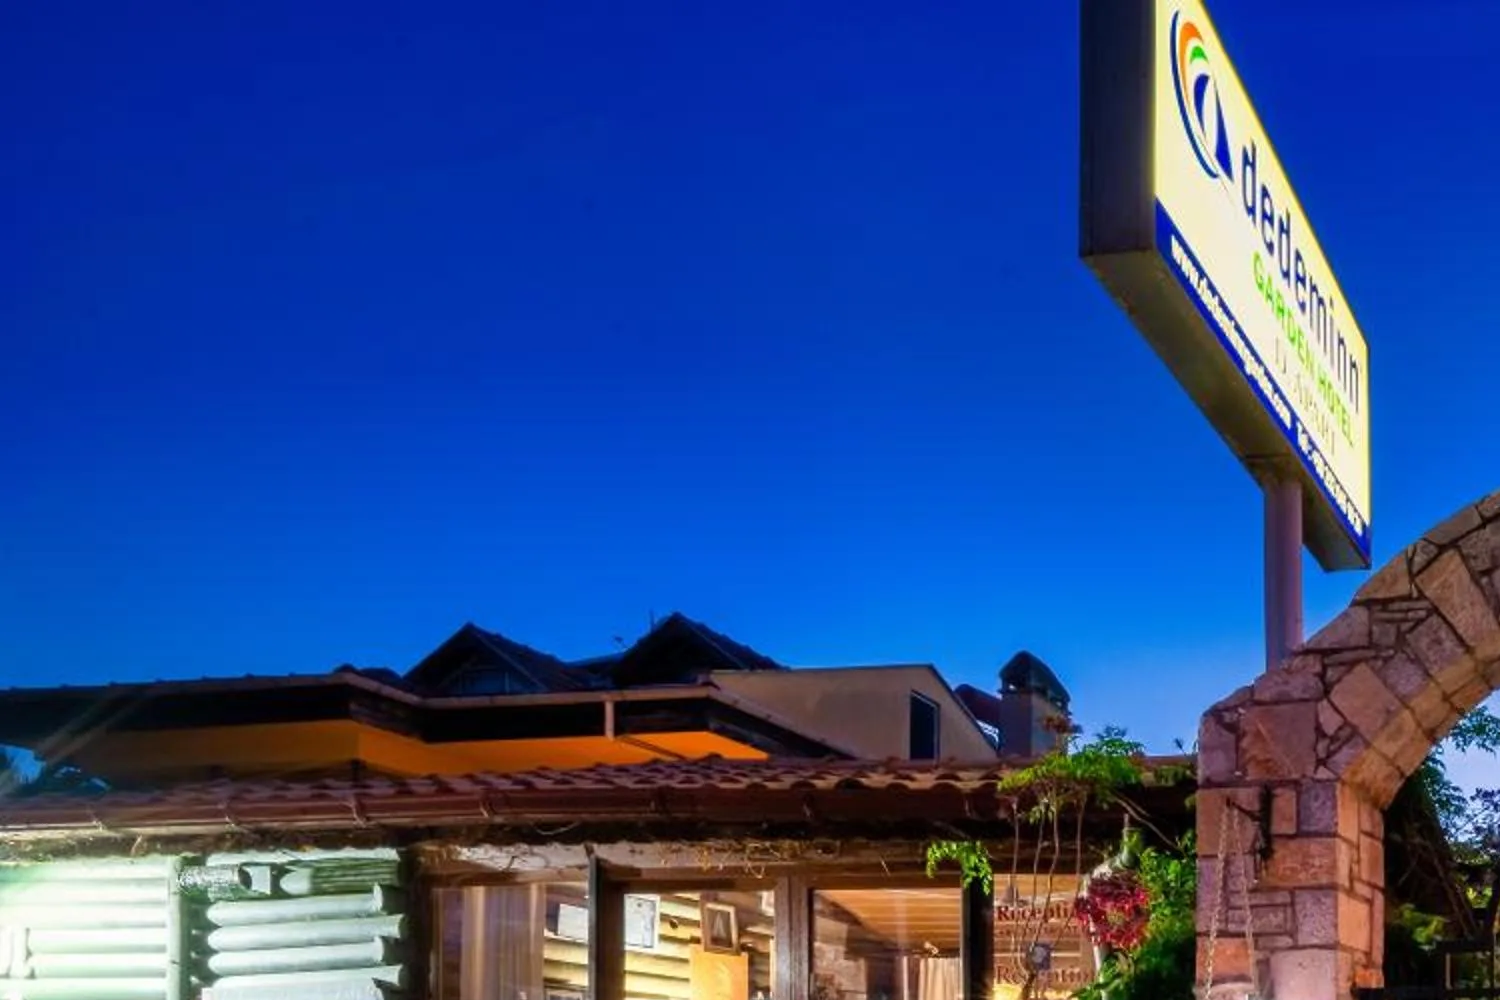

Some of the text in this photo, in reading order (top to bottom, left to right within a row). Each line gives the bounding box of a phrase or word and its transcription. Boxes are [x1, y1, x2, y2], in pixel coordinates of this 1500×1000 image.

[1242, 139, 1359, 414] dedeminn
[1253, 250, 1314, 380] GARDEN
[1317, 366, 1354, 447] HOTEL
